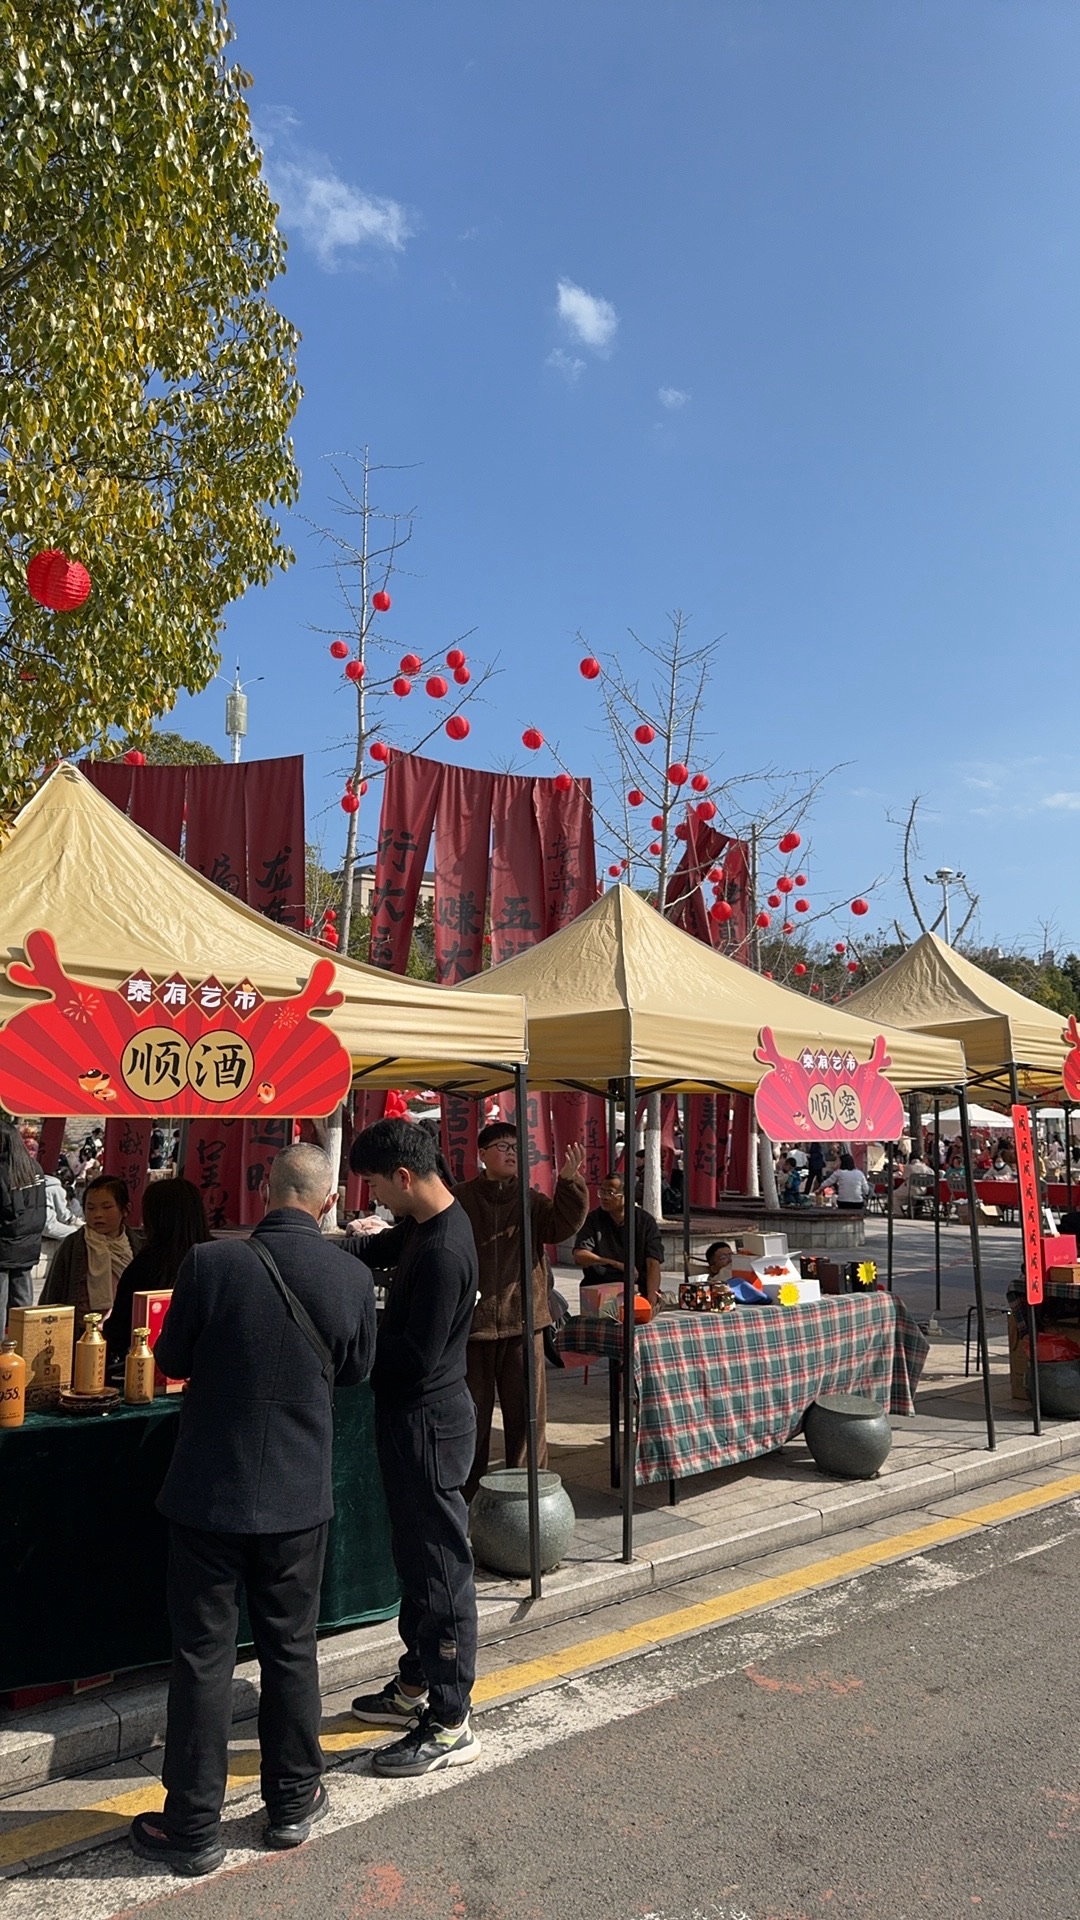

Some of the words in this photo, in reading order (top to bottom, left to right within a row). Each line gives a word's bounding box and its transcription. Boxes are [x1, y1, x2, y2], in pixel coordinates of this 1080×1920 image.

[127, 979, 257, 1010] 泰有艺市
[126, 1040, 246, 1089] 顺酒
[802, 1053, 856, 1071] 泰有艺市
[810, 1090, 858, 1125] 顺蜜
